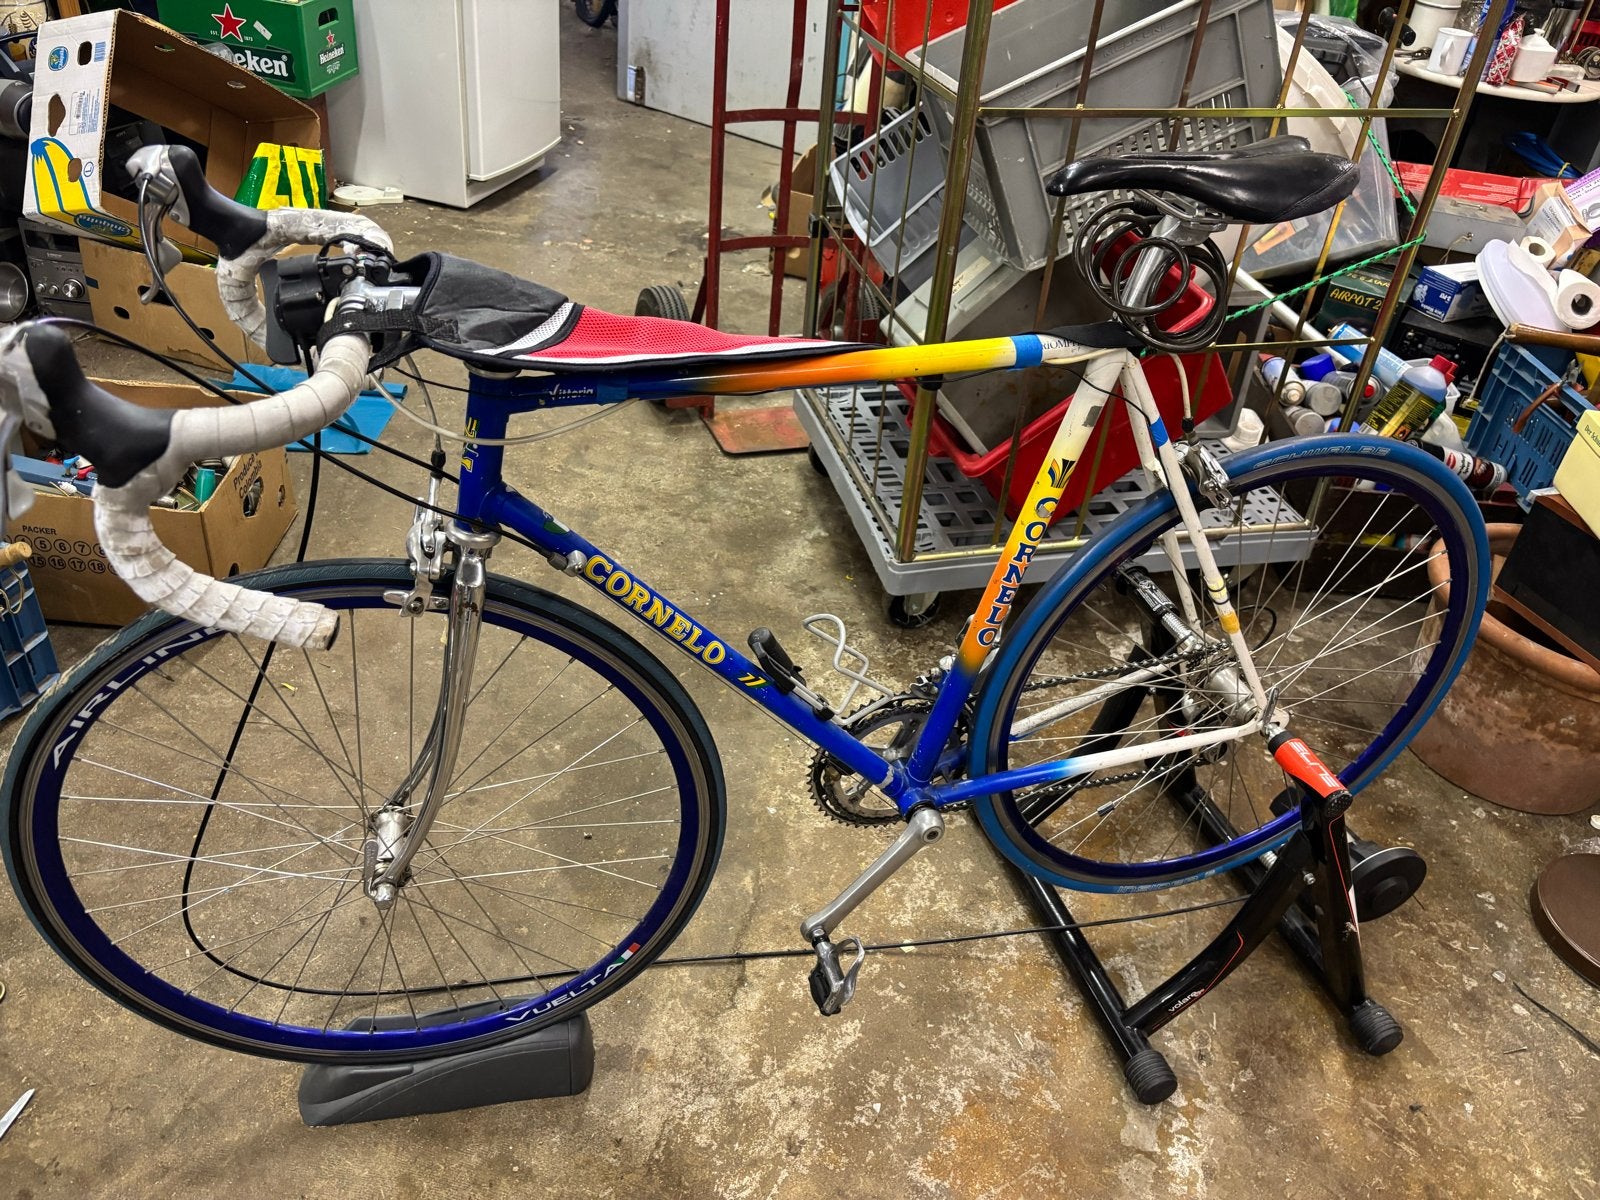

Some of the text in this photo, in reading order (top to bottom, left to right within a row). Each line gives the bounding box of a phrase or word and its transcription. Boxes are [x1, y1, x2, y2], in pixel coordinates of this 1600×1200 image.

[1330, 288, 1375, 308] AIRPOT
[549, 384, 594, 400] Vittoria
[233, 453, 255, 490] Produce
[239, 460, 262, 499] Colombia
[22, 525, 57, 536] PACKER
[39, 540, 47, 549] 5
[58, 543, 66, 552] 6
[78, 544, 85, 553] 7
[52, 558, 65, 568] 16
[71, 560, 84, 570] 17
[91, 562, 104, 572] 18
[977, 497, 1059, 646] CORNELO
[584, 555, 726, 664] CORNELO
[505, 962, 624, 1022] VUELTA
[1168, 992, 1198, 1012] volare
